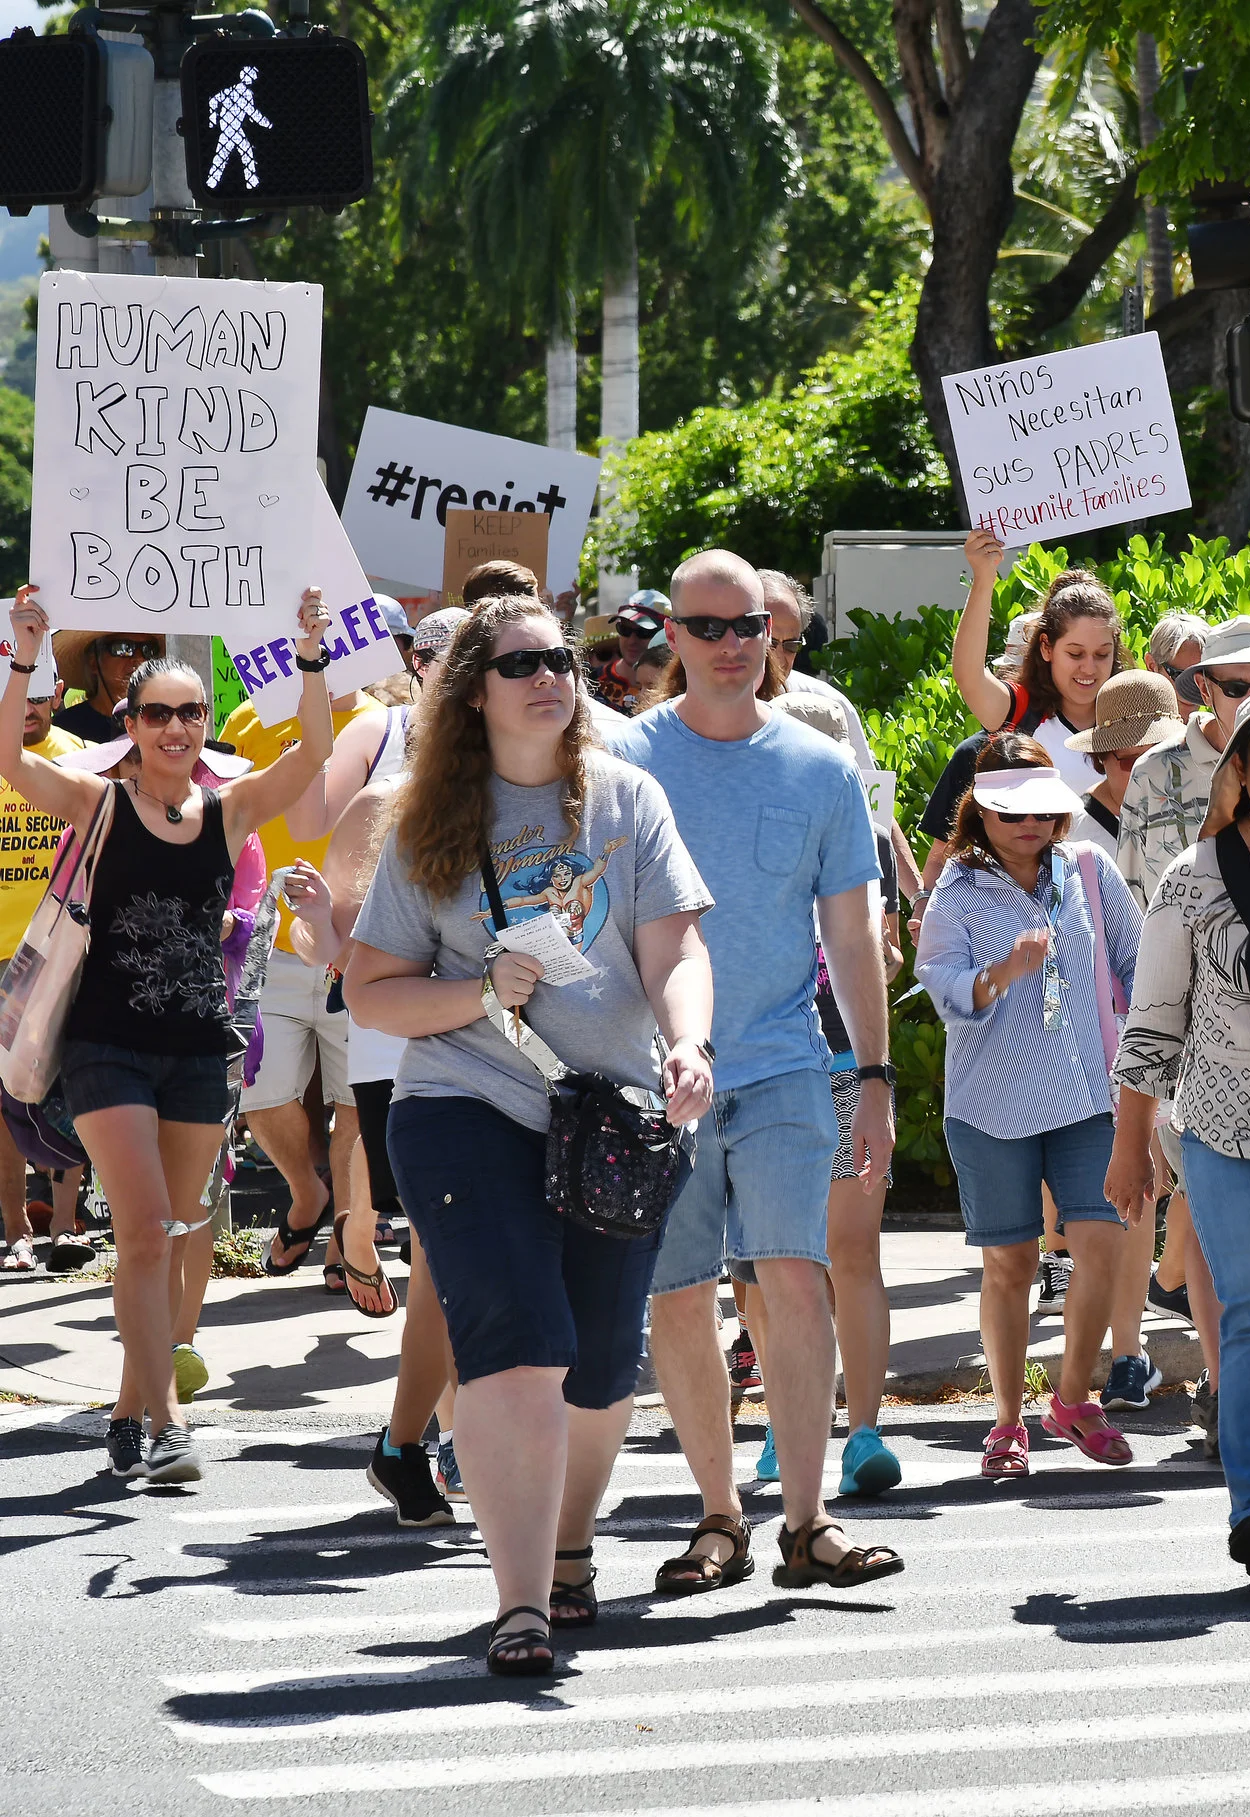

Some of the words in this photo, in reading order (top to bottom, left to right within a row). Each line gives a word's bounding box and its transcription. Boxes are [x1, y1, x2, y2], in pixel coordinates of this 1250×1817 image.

[56, 302, 286, 374] HUMAN
[74, 381, 278, 456] KIND
[1008, 386, 1142, 441] Necesitan
[1053, 422, 1169, 489] PADRES
[126, 464, 225, 533] BE
[473, 515, 522, 535] KEEP
[70, 532, 265, 612] BOTH
[233, 597, 390, 694] REFGEE
